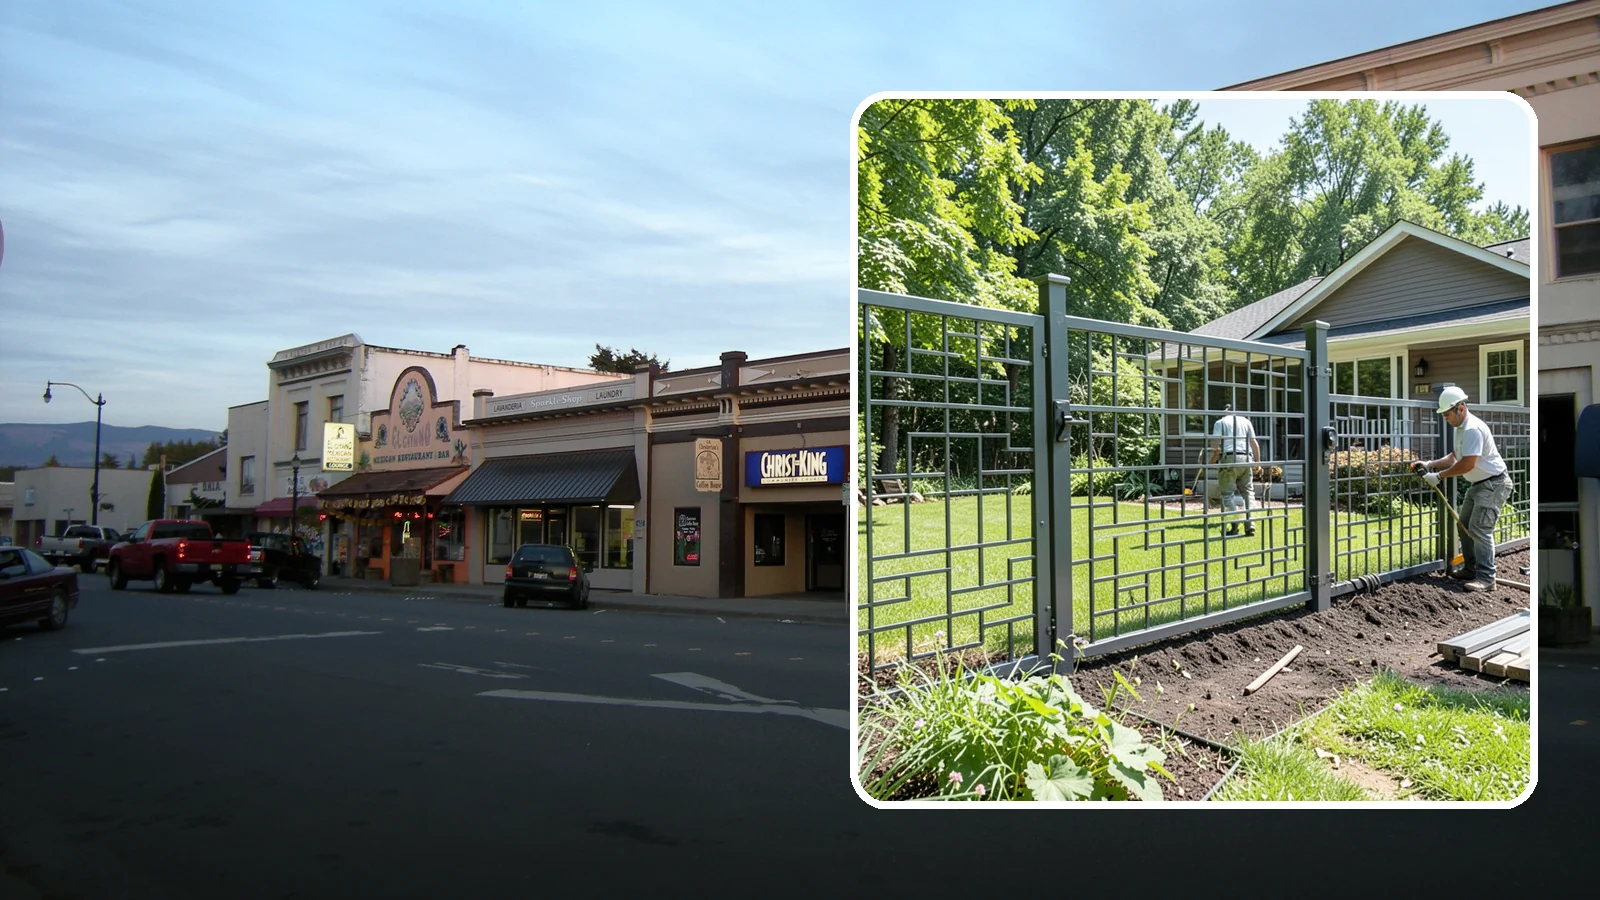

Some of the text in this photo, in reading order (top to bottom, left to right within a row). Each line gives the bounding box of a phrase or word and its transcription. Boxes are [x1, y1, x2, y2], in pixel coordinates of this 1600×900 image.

[493, 389, 624, 413] LAVANDERIA Sparkle Shop LAUNDRY
[327, 440, 333, 450] EL
[392, 425, 402, 449] EL
[374, 454, 396, 464] MEXICAN
[397, 451, 433, 462] RESTAURANT
[438, 450, 450, 459] BAR
[761, 452, 797, 477] CHRIST
[799, 450, 827, 475] KING
[696, 481, 722, 489] Coffee House
